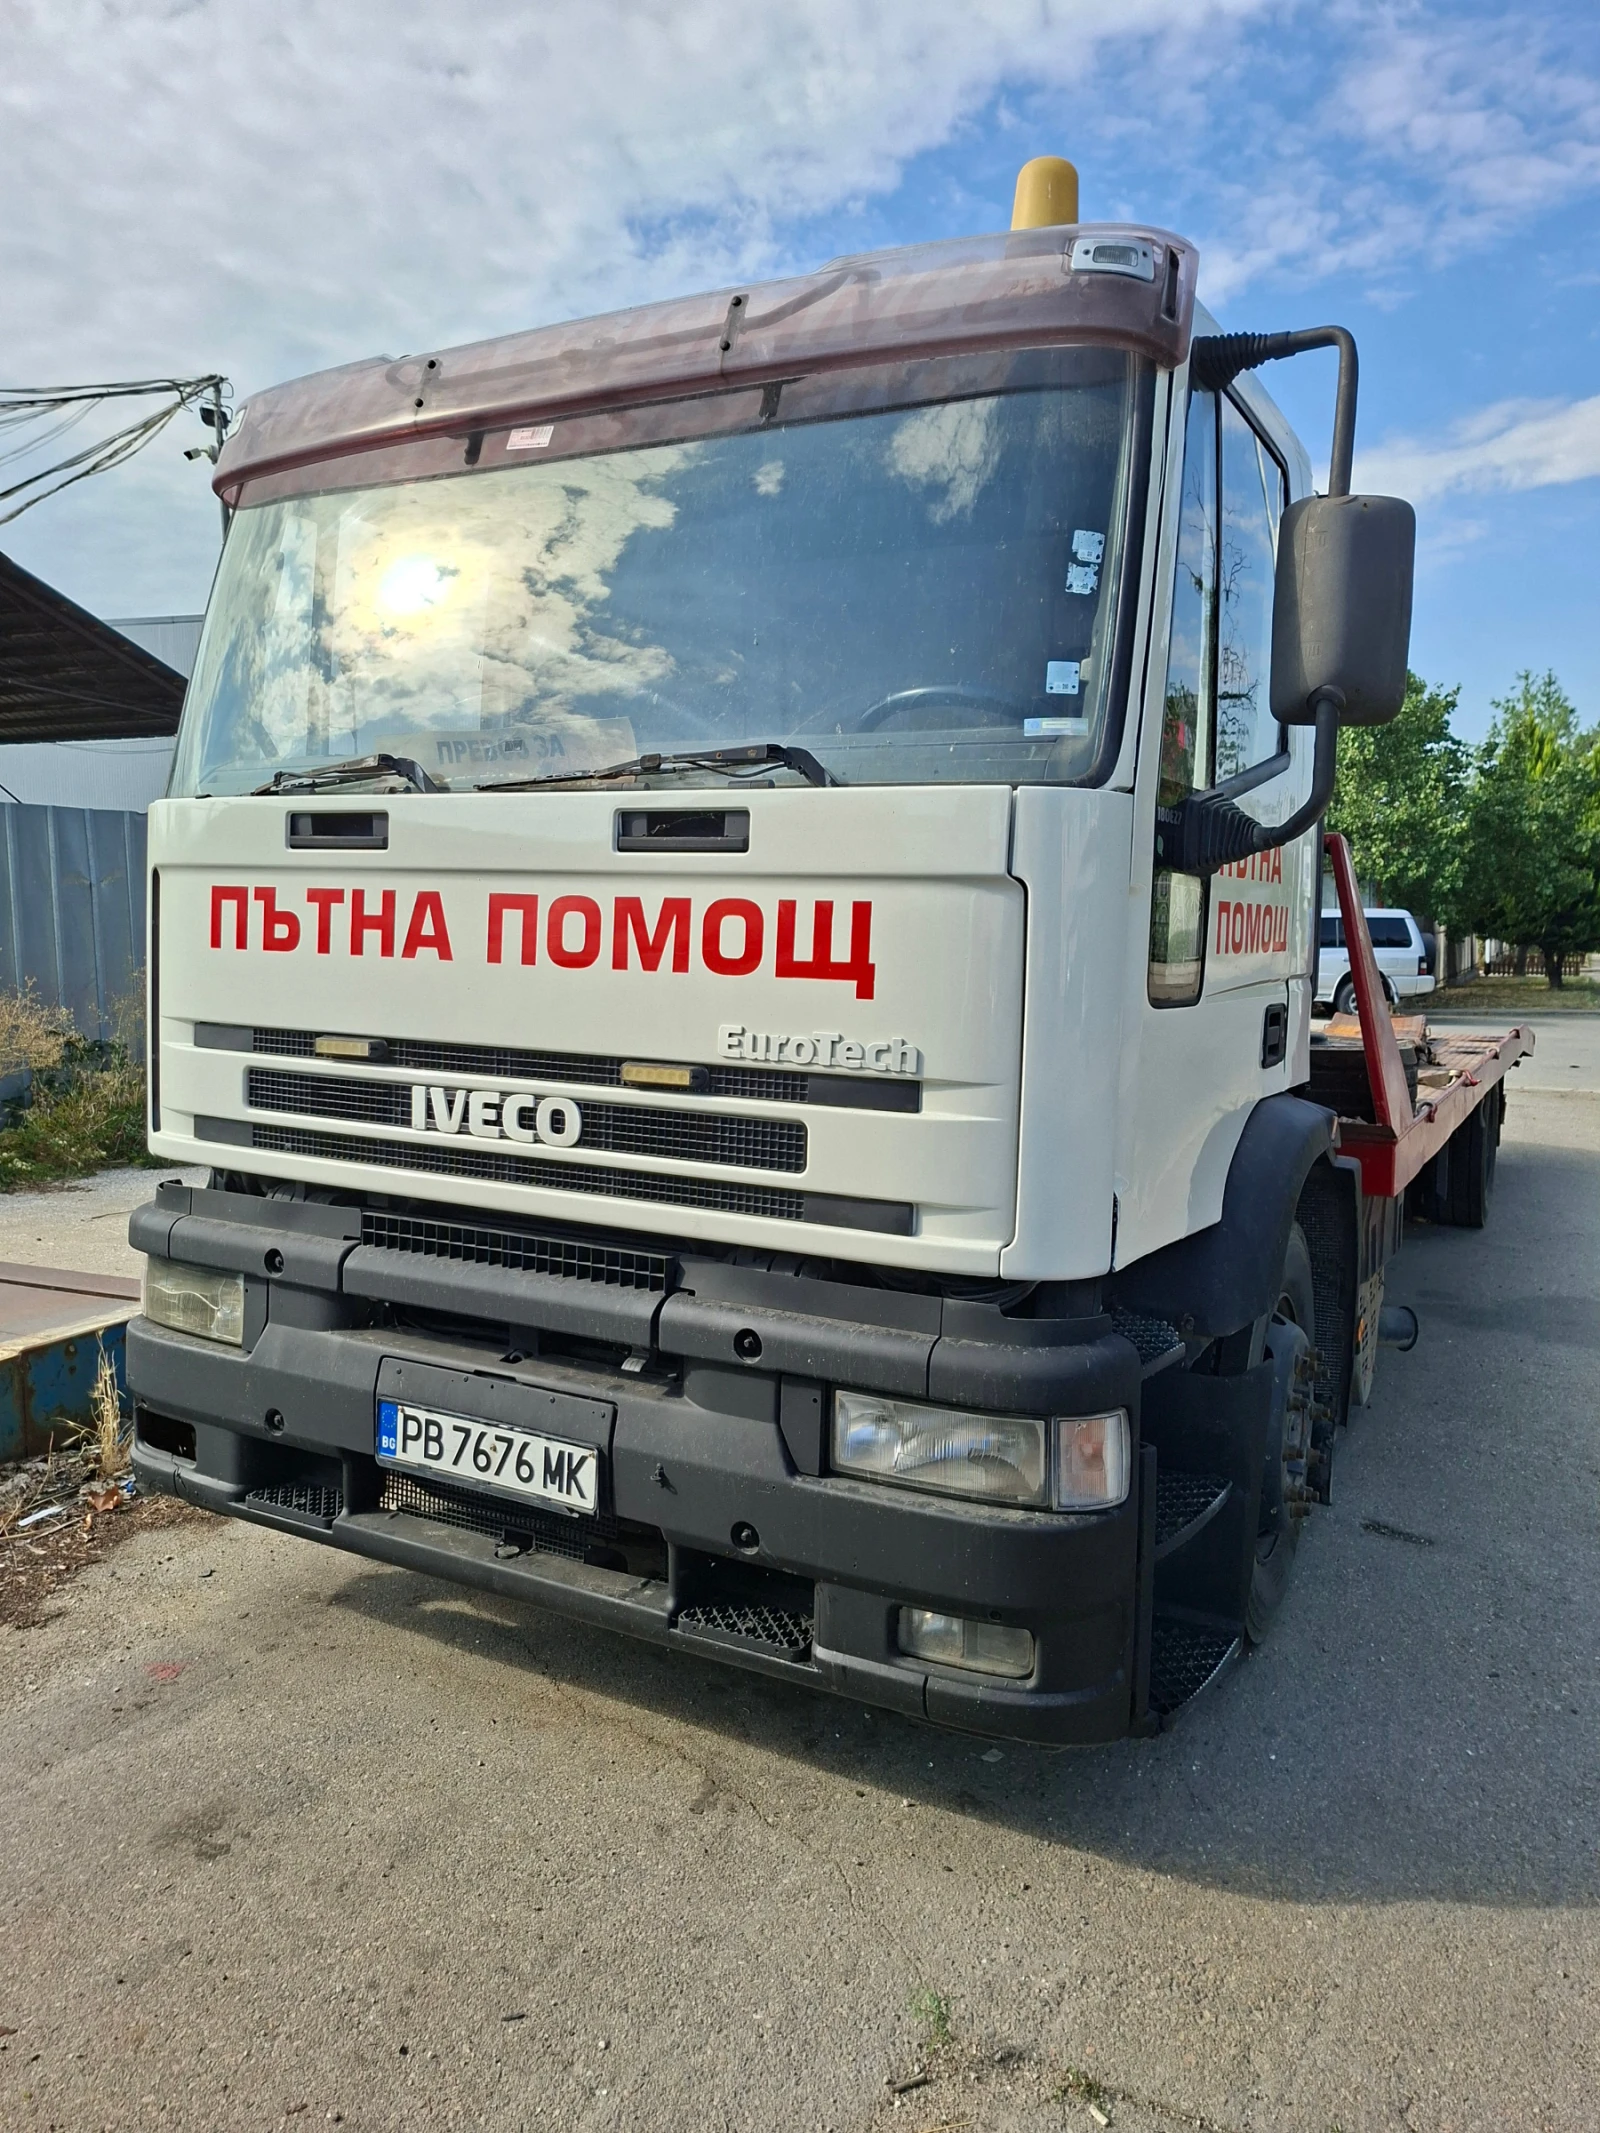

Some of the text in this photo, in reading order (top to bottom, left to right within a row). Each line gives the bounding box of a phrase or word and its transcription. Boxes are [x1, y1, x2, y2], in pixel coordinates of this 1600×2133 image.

[209, 885, 877, 1001] ПЪТНА ПОМОЩ
[718, 1024, 920, 1074] EuroTech
[411, 1085, 582, 1147] IVECO
[381, 1435, 397, 1450] BG
